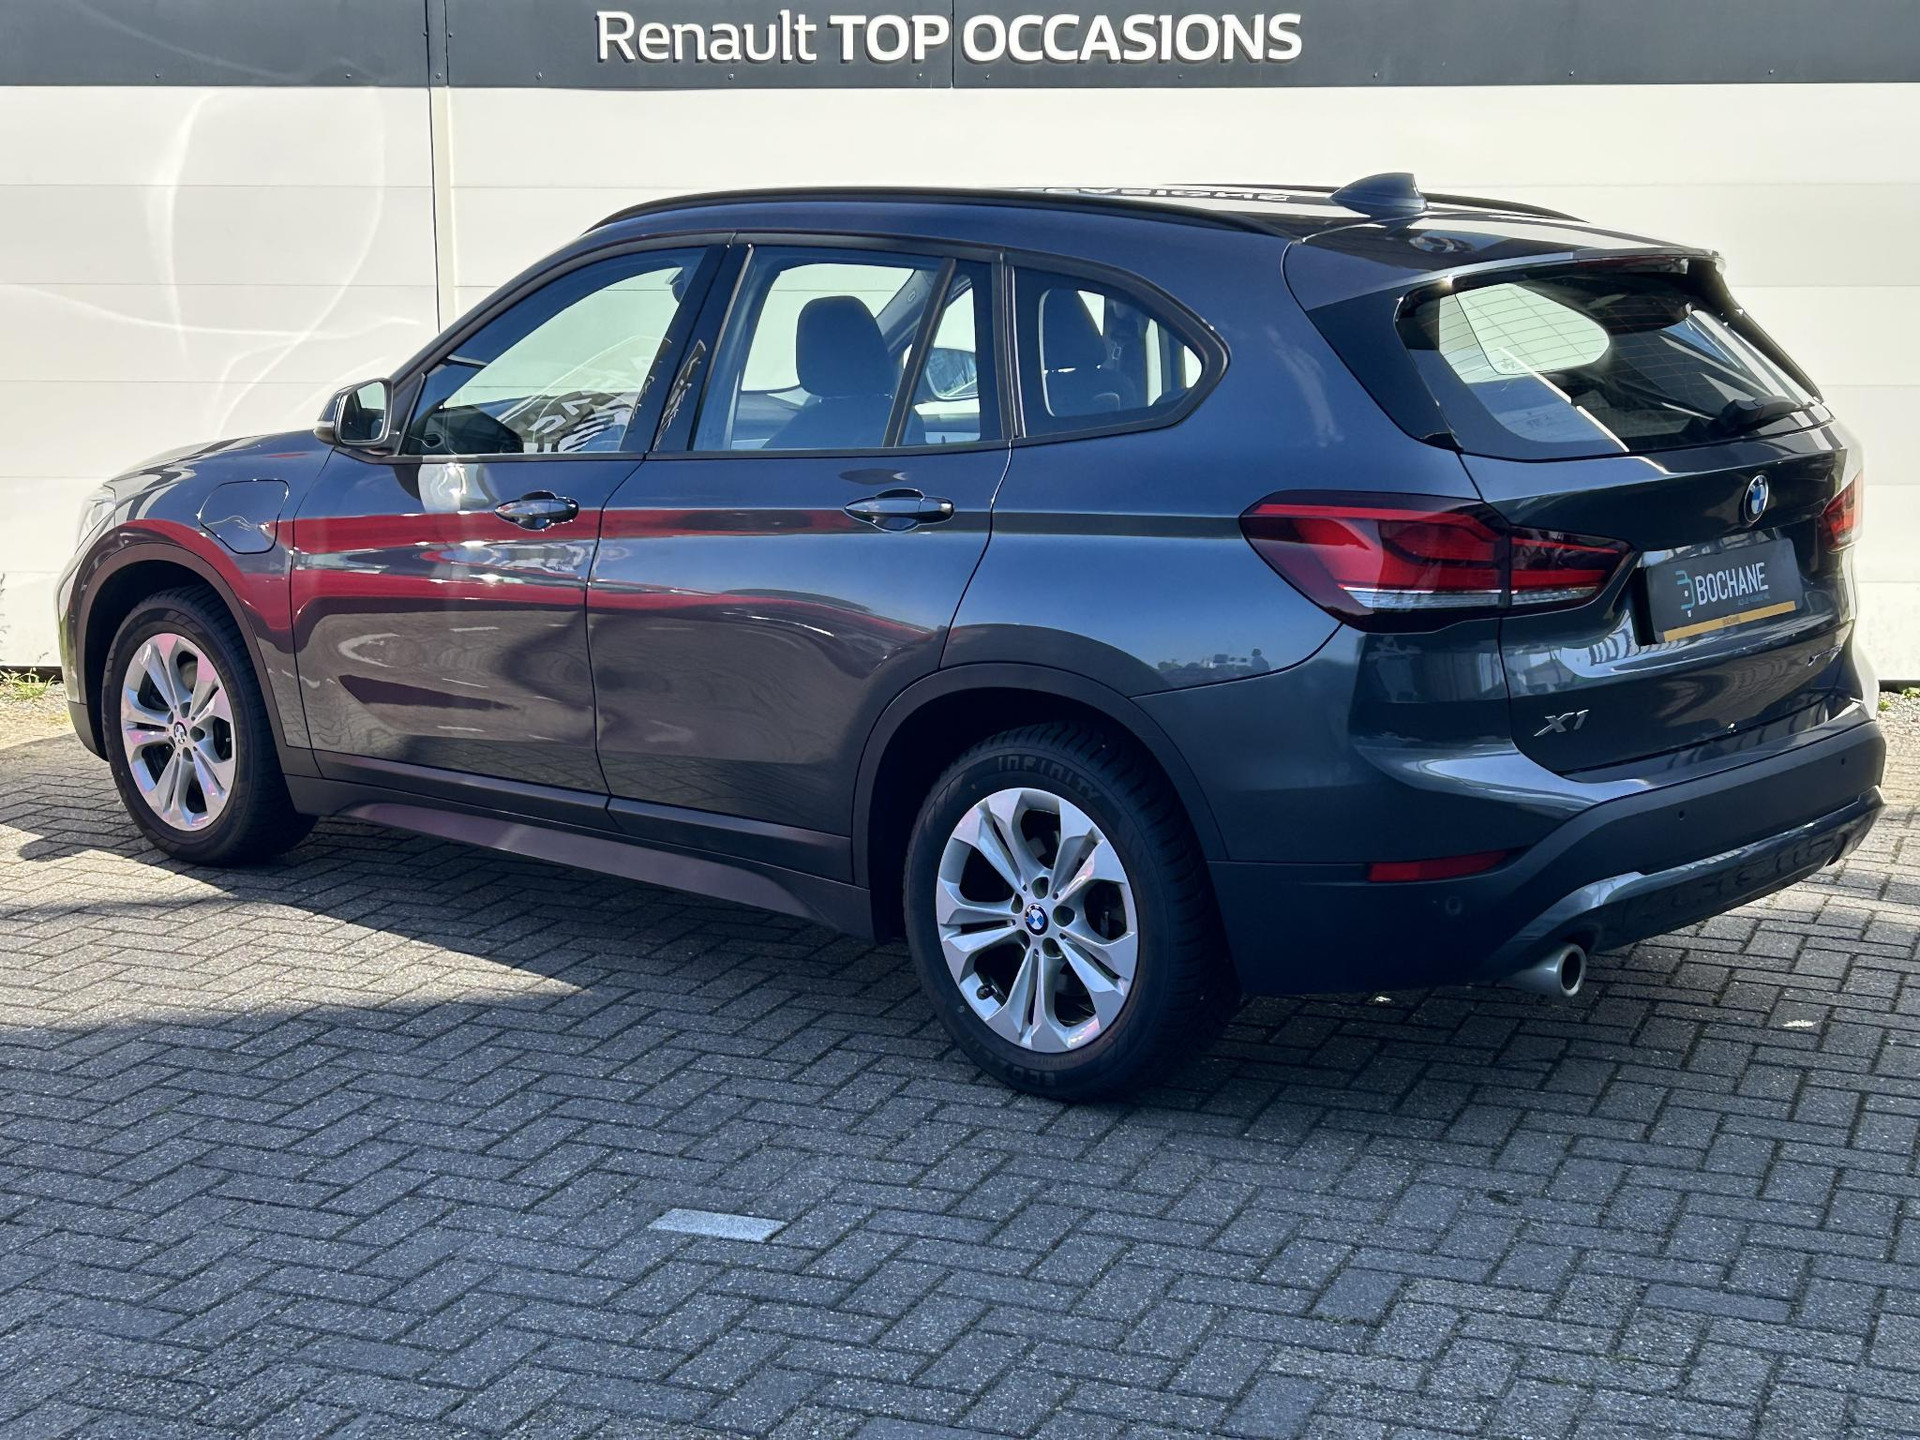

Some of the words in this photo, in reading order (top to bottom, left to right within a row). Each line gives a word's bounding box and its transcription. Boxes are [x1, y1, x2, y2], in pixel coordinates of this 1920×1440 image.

[597, 9, 817, 62] Renault
[828, 13, 950, 62] TOP
[962, 13, 1303, 62] OCCASIONS
[1695, 561, 1769, 606] BOCHANE
[1533, 709, 1589, 737] X1
